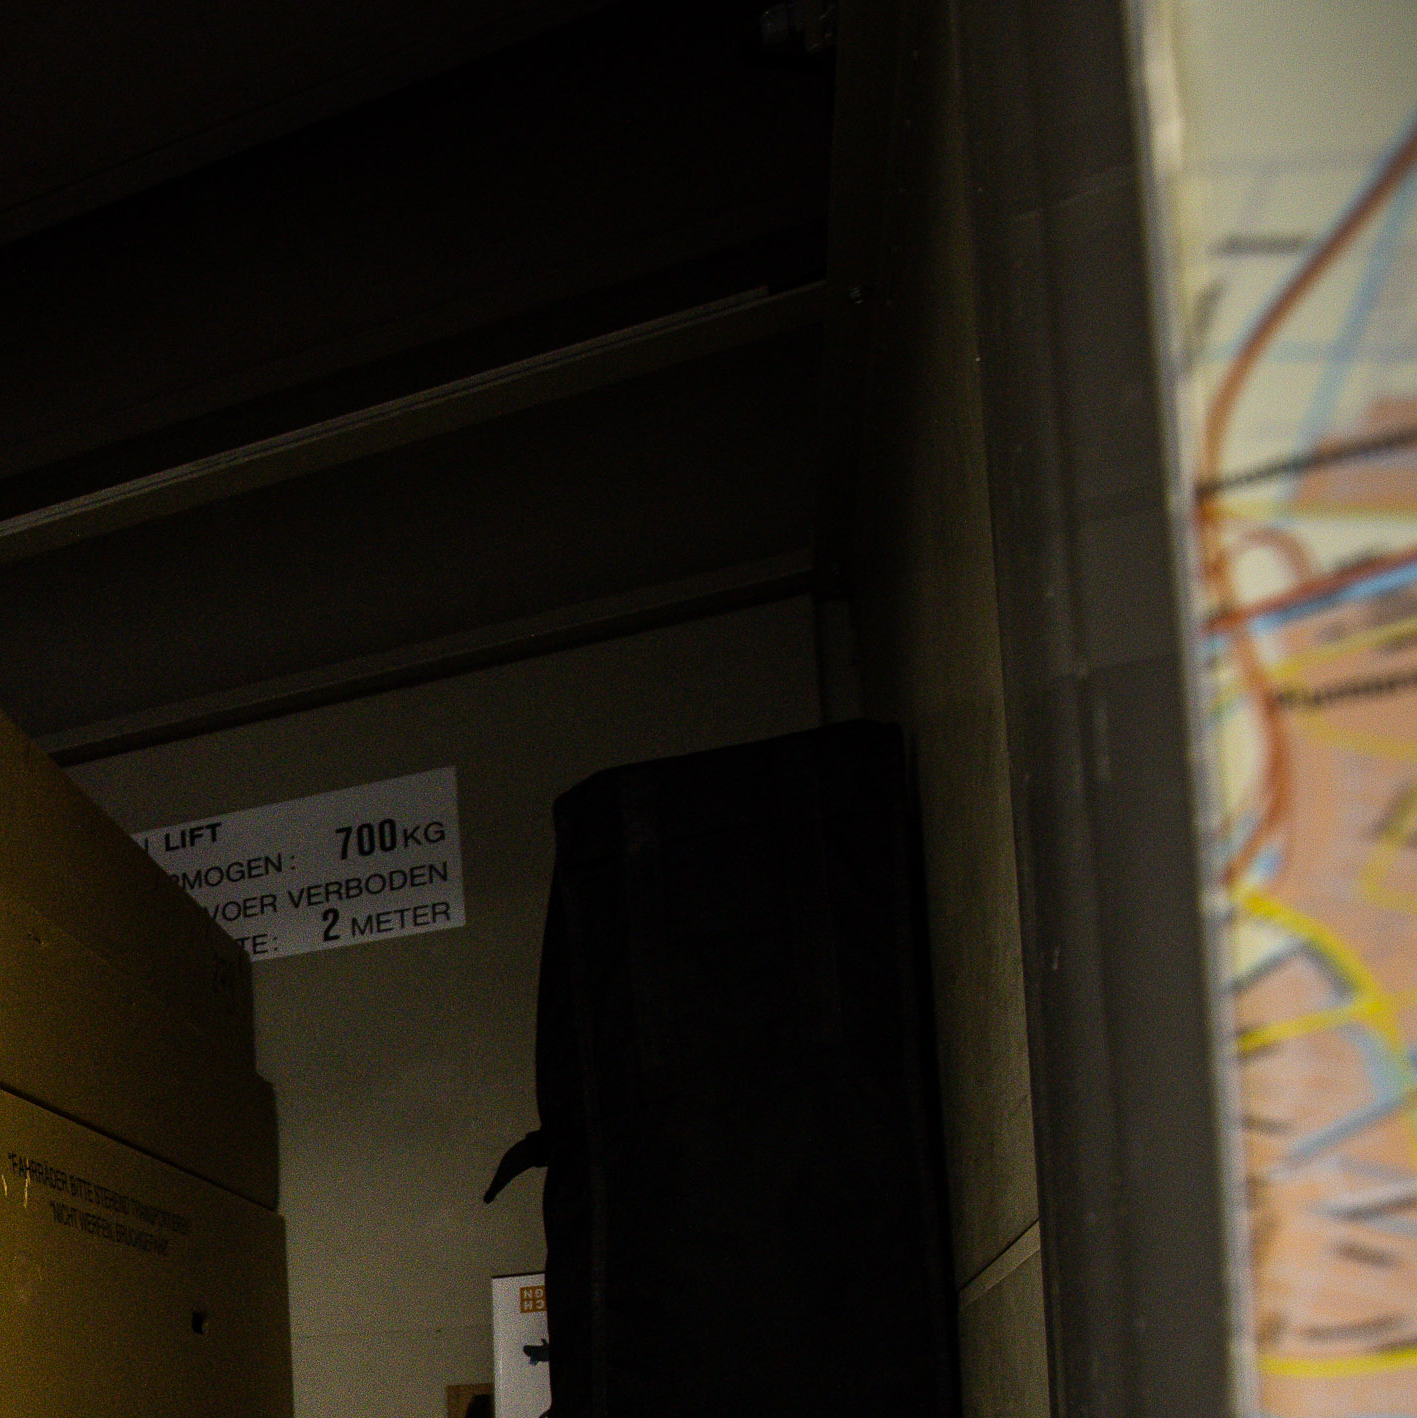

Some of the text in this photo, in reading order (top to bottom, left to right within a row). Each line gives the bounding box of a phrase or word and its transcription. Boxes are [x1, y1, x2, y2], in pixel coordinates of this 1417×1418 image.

[165, 823, 222, 851] LIFT
[335, 818, 397, 861] 700
[403, 822, 446, 848] KG
[287, 861, 448, 908] VERBODEN
[322, 908, 339, 942] 2
[351, 901, 450, 937] METER
